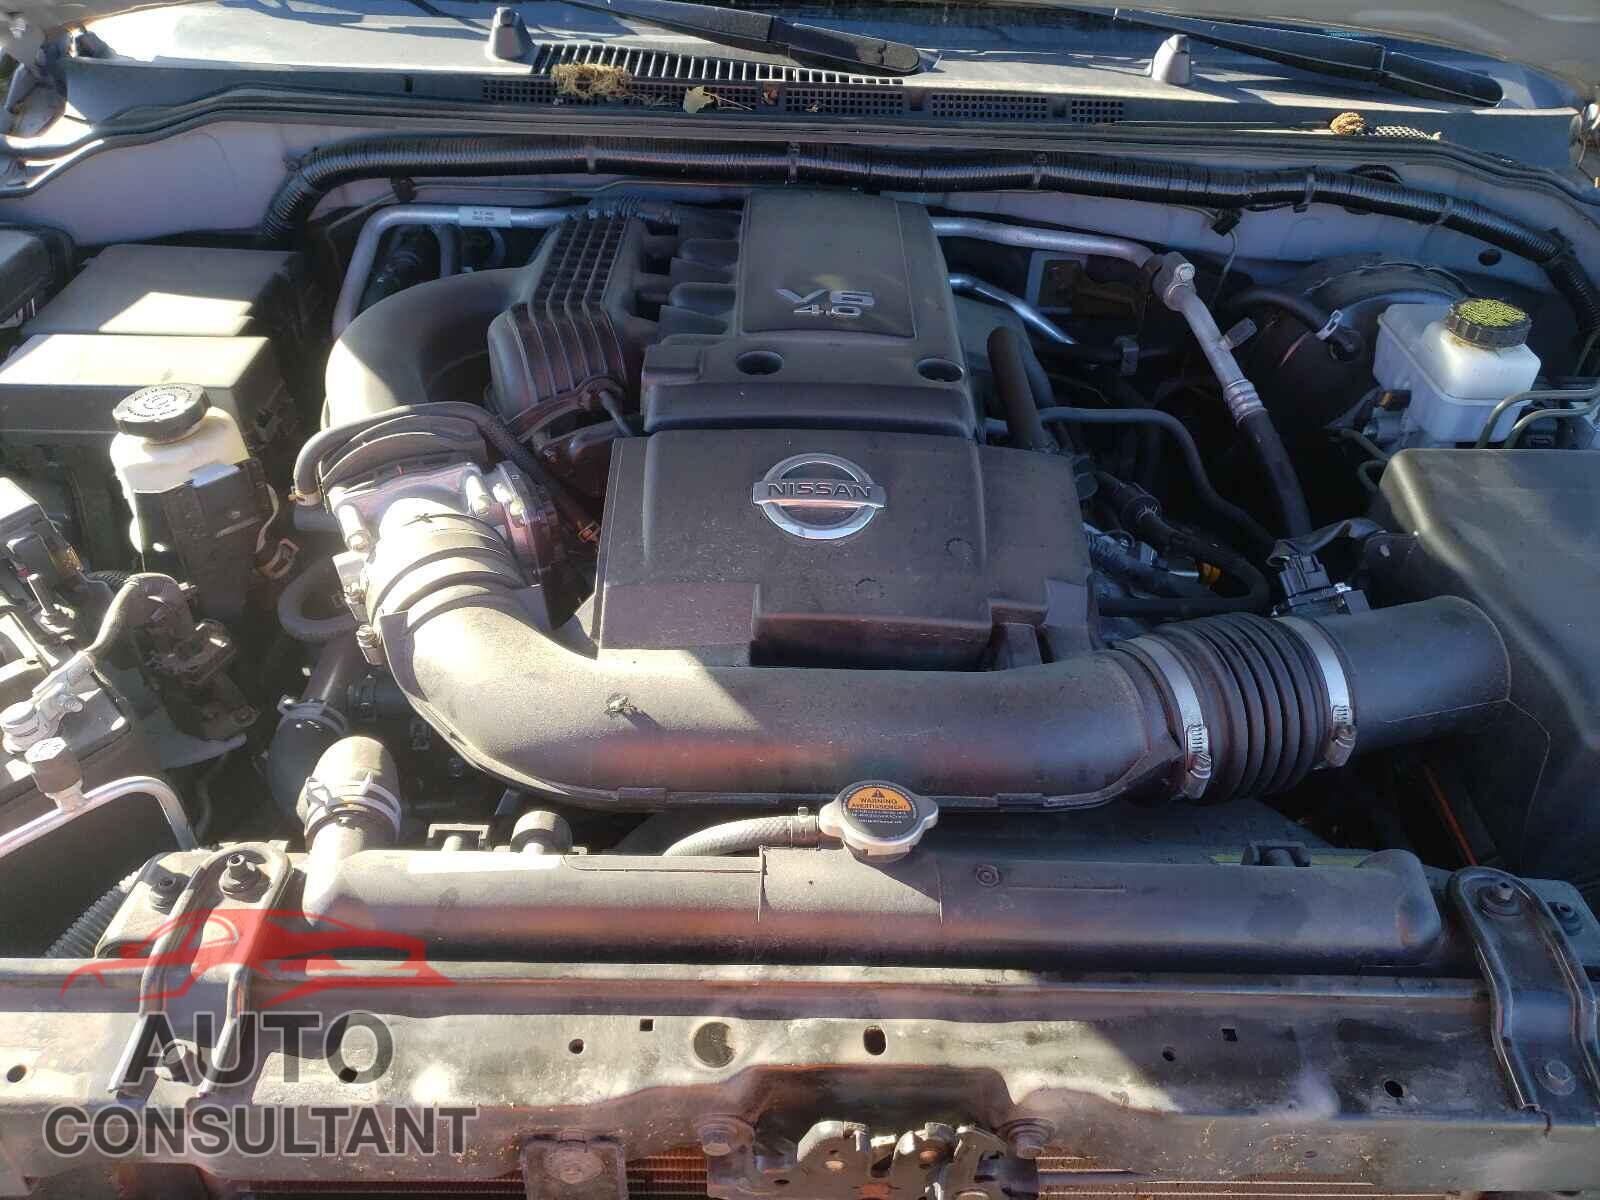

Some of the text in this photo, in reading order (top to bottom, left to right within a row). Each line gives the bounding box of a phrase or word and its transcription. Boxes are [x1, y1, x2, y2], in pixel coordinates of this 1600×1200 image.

[776, 288, 875, 306] V6
[793, 304, 862, 317] 4.0
[767, 482, 871, 499] NISSAN
